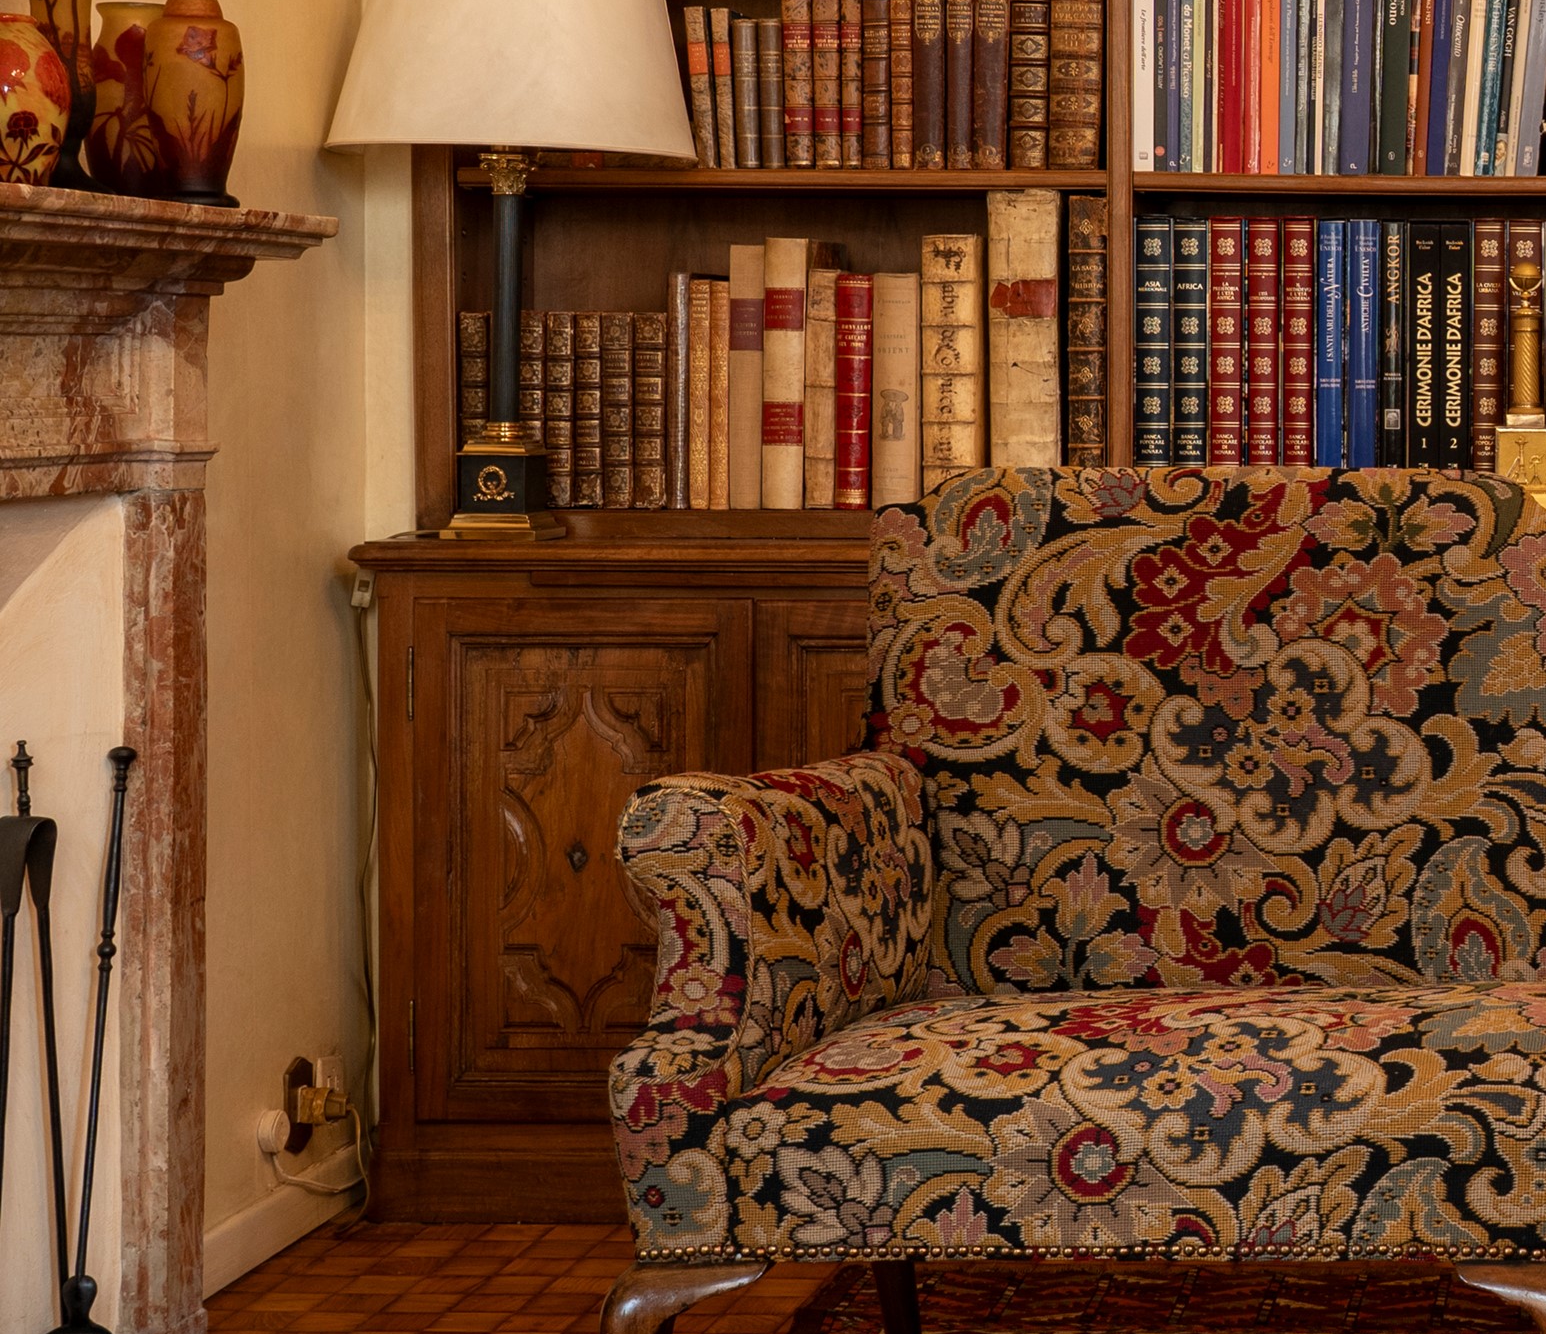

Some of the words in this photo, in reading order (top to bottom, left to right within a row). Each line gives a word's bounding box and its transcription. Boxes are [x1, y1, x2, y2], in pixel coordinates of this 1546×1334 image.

[1184, 5, 1190, 17] da
[1506, 7, 1515, 25] VAN
[1453, 15, 1465, 57] Ottocento
[1504, 28, 1513, 57] GOGH
[1387, 235, 1400, 304] ANGKOR
[1417, 272, 1431, 344] D'AFRICA
[1446, 272, 1461, 344] D'AFRICA
[1417, 345, 1431, 426] CERIMONIE
[1446, 345, 1461, 426] CERIMONIE
[1421, 438, 1426, 448] 1
[1450, 438, 1458, 449] 2
